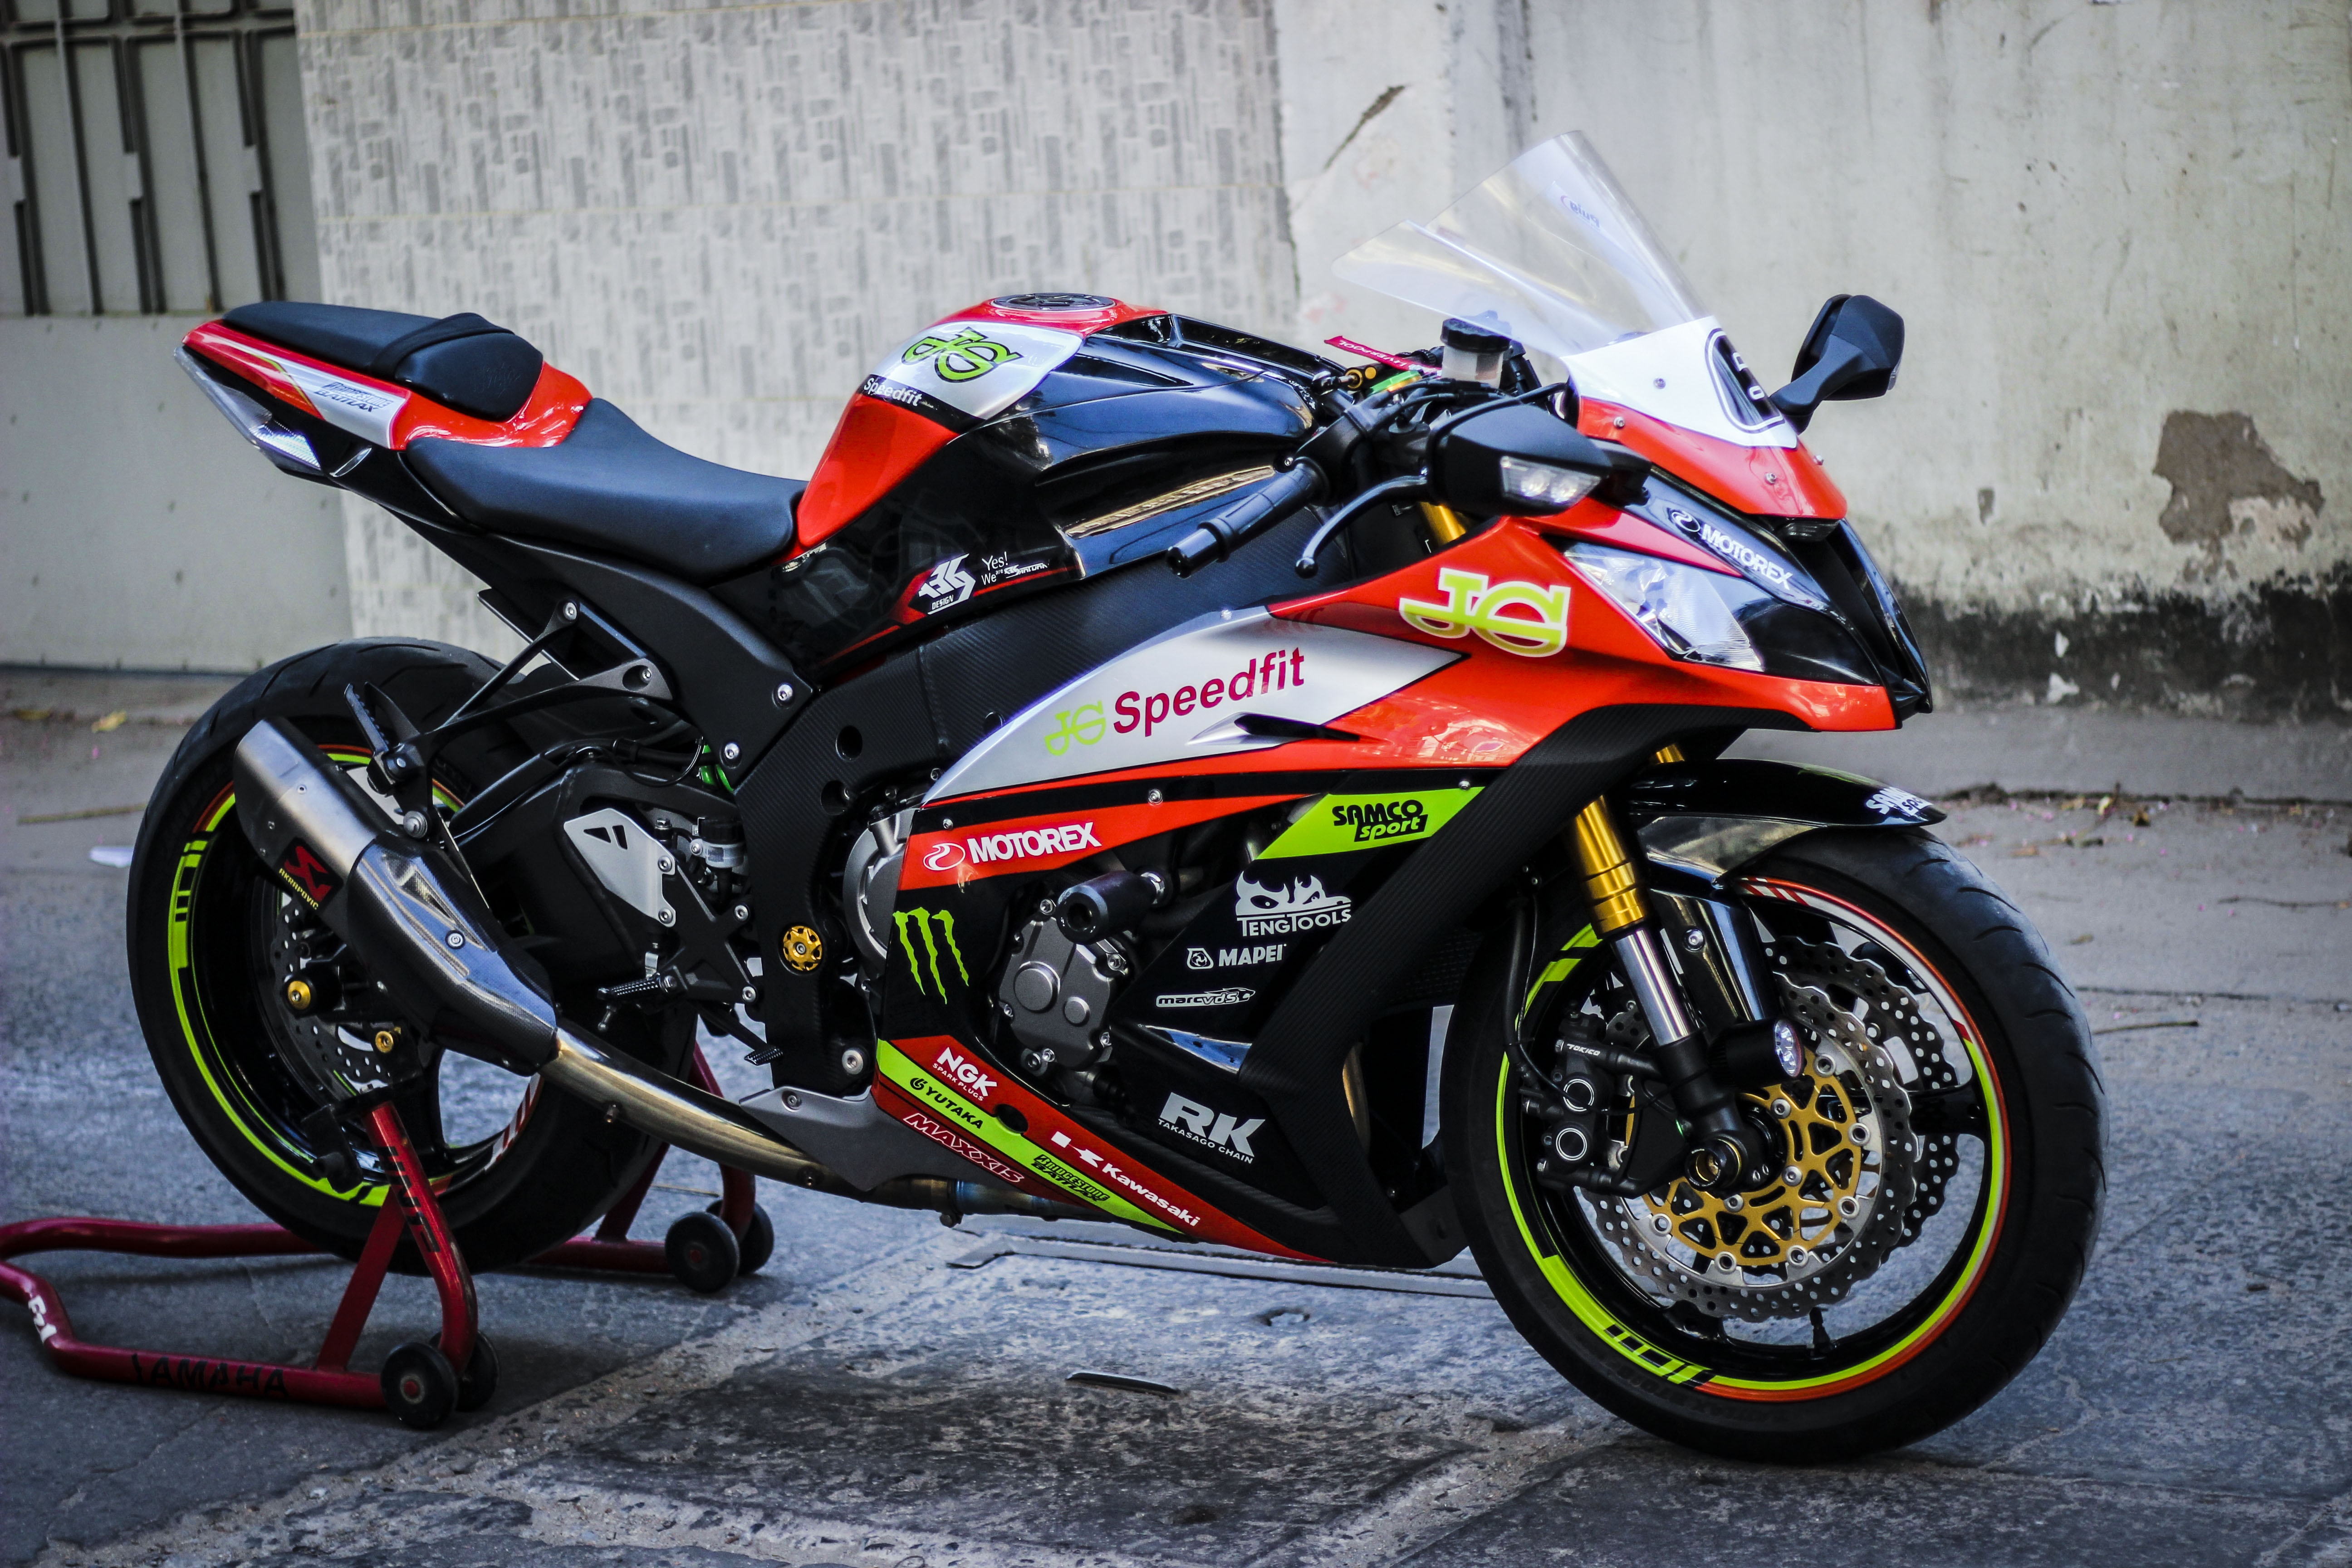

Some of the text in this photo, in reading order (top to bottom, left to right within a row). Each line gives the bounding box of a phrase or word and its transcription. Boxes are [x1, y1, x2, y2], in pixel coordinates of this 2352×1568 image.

[1338, 340, 1407, 367] LIVERPOOL
[863, 377, 922, 407] Speedfit
[981, 551, 1008, 571] Yes!
[1701, 523, 1793, 590] MOTOREX
[981, 573, 997, 585] We
[931, 595, 954, 610] DESIGN
[1113, 647, 1304, 737] Speedfit
[1332, 800, 1423, 826] SAMCO
[1359, 818, 1421, 840] sport
[968, 822, 1102, 863] MOTOREX
[1219, 944, 1283, 967] MAPEI
[1566, 1043, 1601, 1056] TOKICO
[933, 1063, 984, 1101] SPARK PLUGS
[936, 1047, 997, 1097] NGK
[926, 1086, 983, 1129] YUTAKA
[1160, 1092, 1265, 1157] RK
[903, 1112, 1024, 1182] MAXXIS
[1158, 1119, 1253, 1164] TAKASAGO CHAIN
[1034, 1154, 1110, 1201] BRIDGESTONE
[1102, 1162, 1200, 1228] Kawasaki
